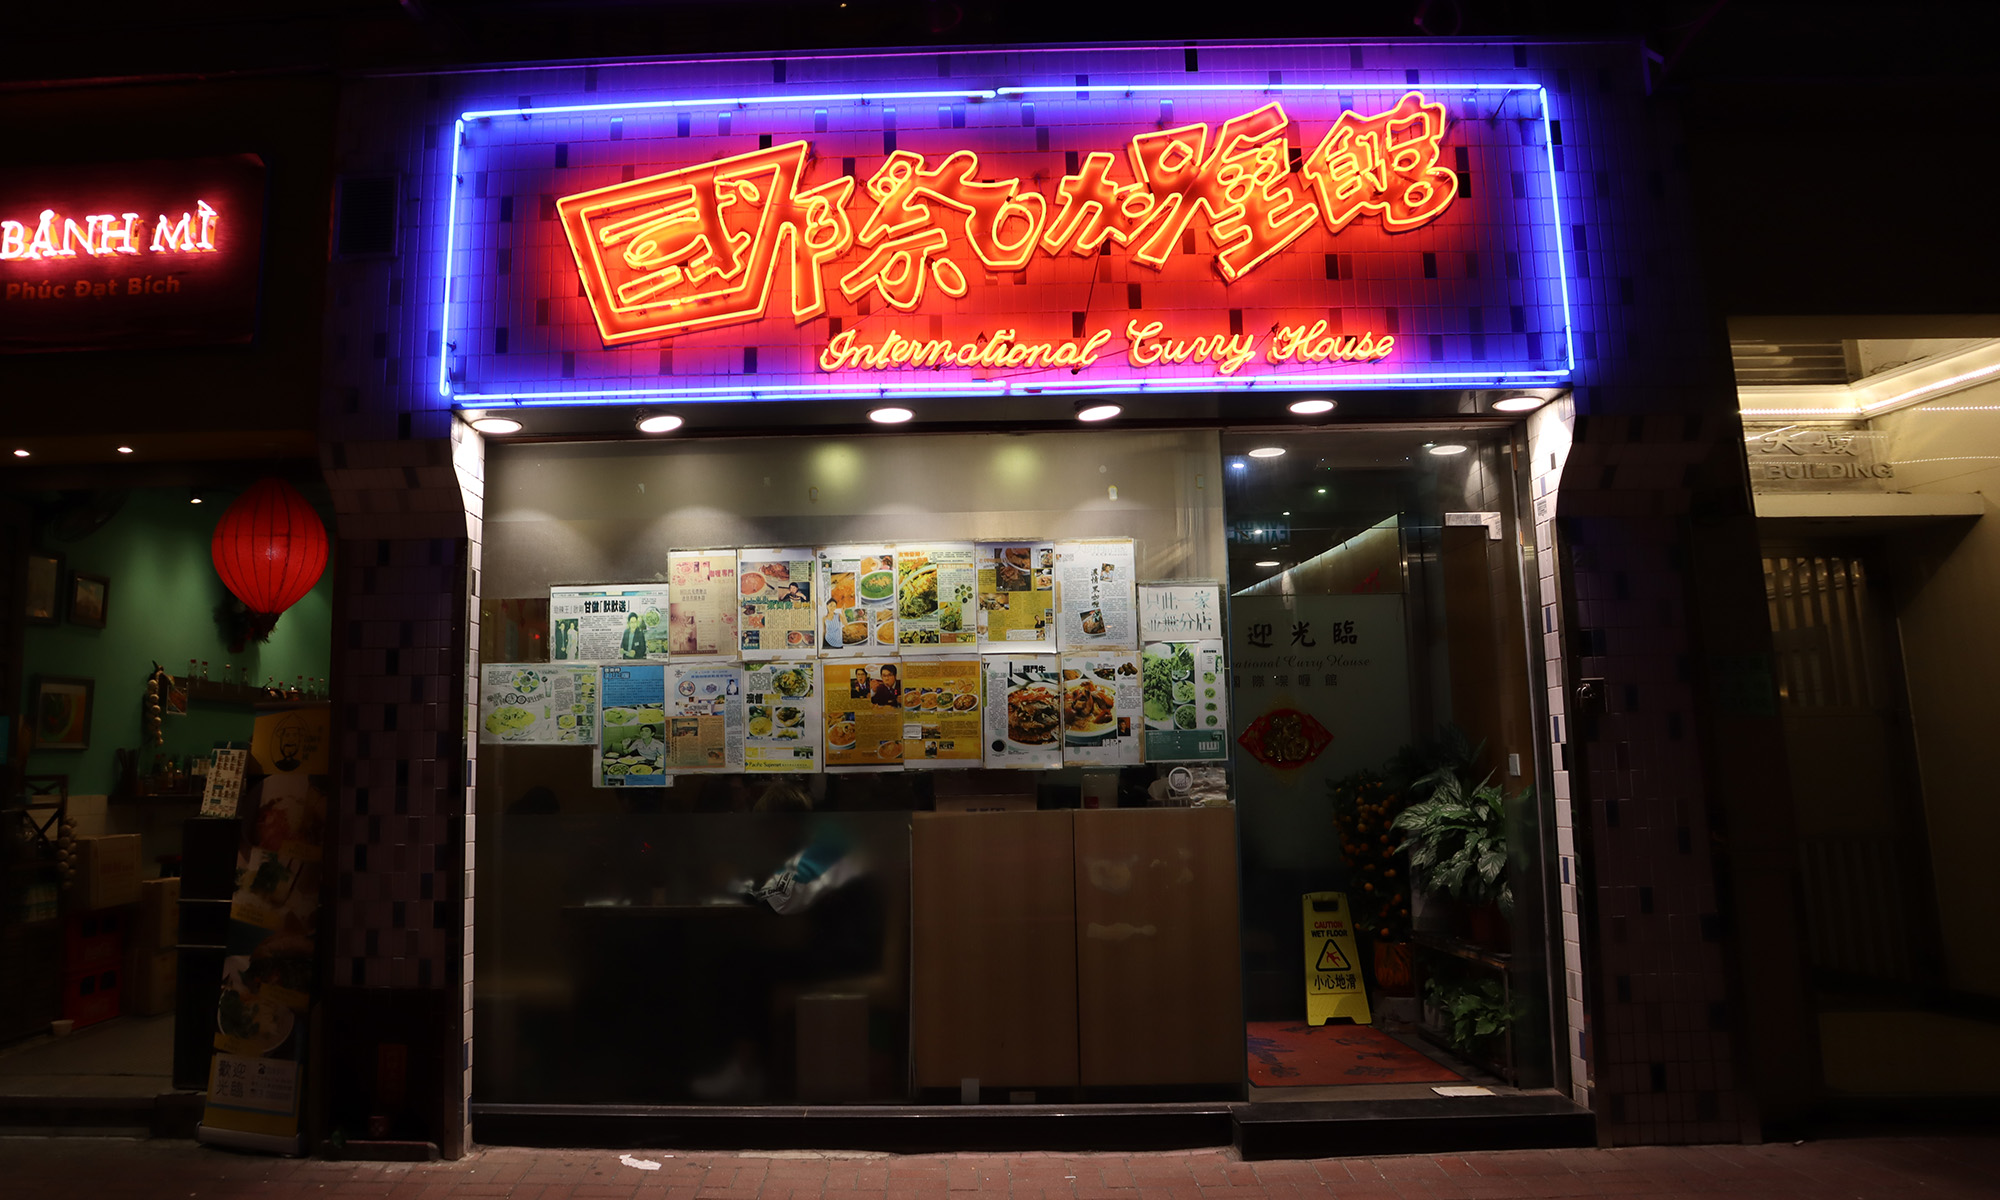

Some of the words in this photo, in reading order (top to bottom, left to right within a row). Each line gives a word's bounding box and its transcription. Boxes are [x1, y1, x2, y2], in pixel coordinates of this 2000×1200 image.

[0, 209, 141, 261] BÁNH
[150, 200, 219, 254] MÌ
[6, 279, 66, 301] Phúc
[74, 280, 118, 301] Đạt
[127, 275, 181, 296] Bích
[820, 328, 1111, 374] International
[1126, 321, 1255, 376] Curry
[1272, 321, 1396, 363] House
[1763, 463, 1894, 480] BUILDING
[1283, 655, 1324, 672] Curry
[1326, 654, 1371, 667] House
[1314, 921, 1343, 929] CAUTION
[1311, 930, 1325, 938] WET
[1326, 930, 1348, 938] FLOOR
[1314, 974, 1357, 991] 小心地滑
